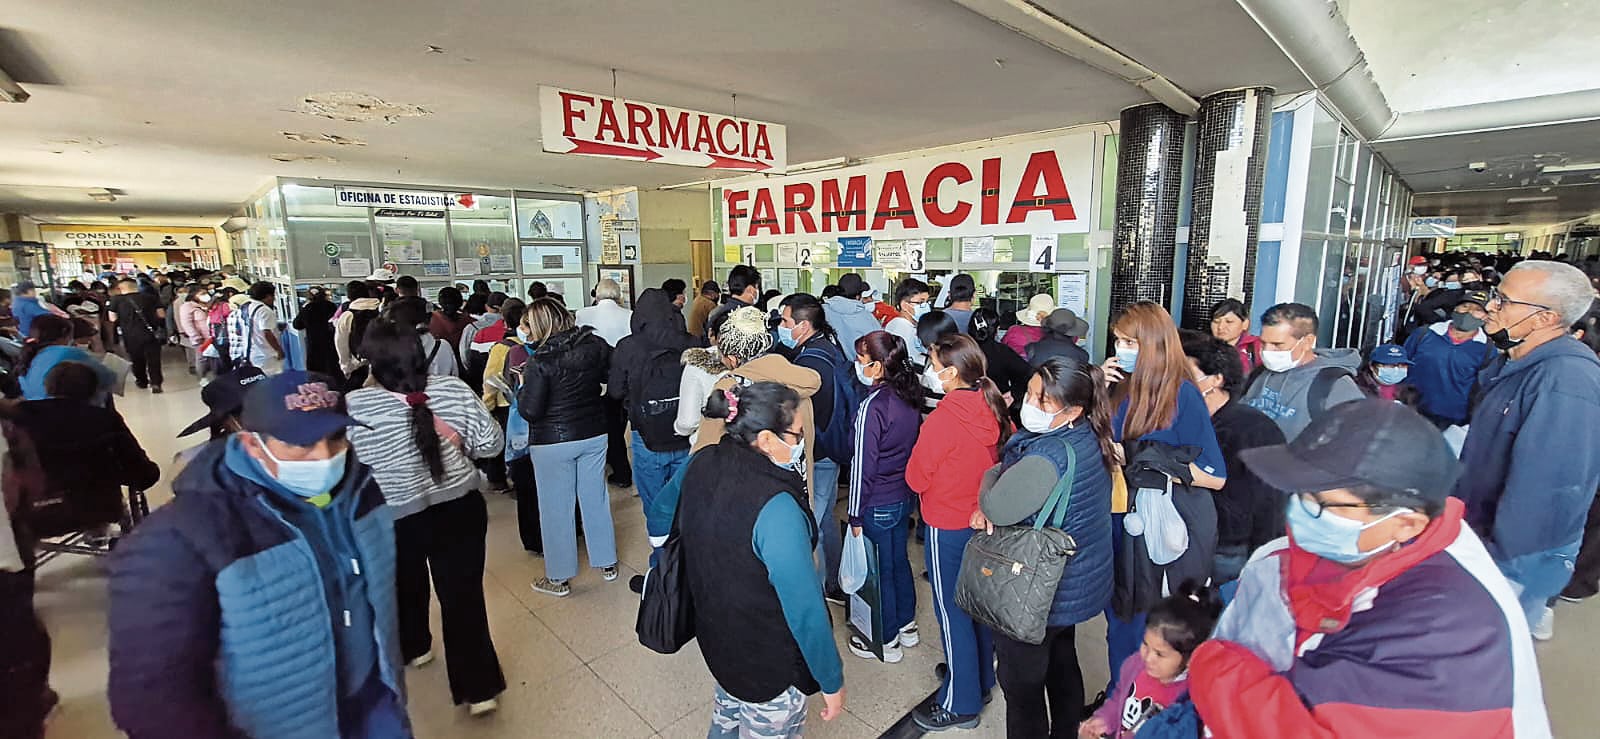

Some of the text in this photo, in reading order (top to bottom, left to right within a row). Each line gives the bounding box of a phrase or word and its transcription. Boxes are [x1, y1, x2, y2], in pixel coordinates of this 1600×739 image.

[558, 91, 775, 161] FARMACIA
[340, 191, 456, 207] OFICINA DE ESTADISTICA
[726, 150, 1077, 238] FARMACIA
[65, 232, 144, 240] CONSULTA
[746, 252, 753, 267] 1
[801, 248, 811, 267] 2
[910, 249, 923, 271] 3
[1035, 245, 1054, 270] 4
